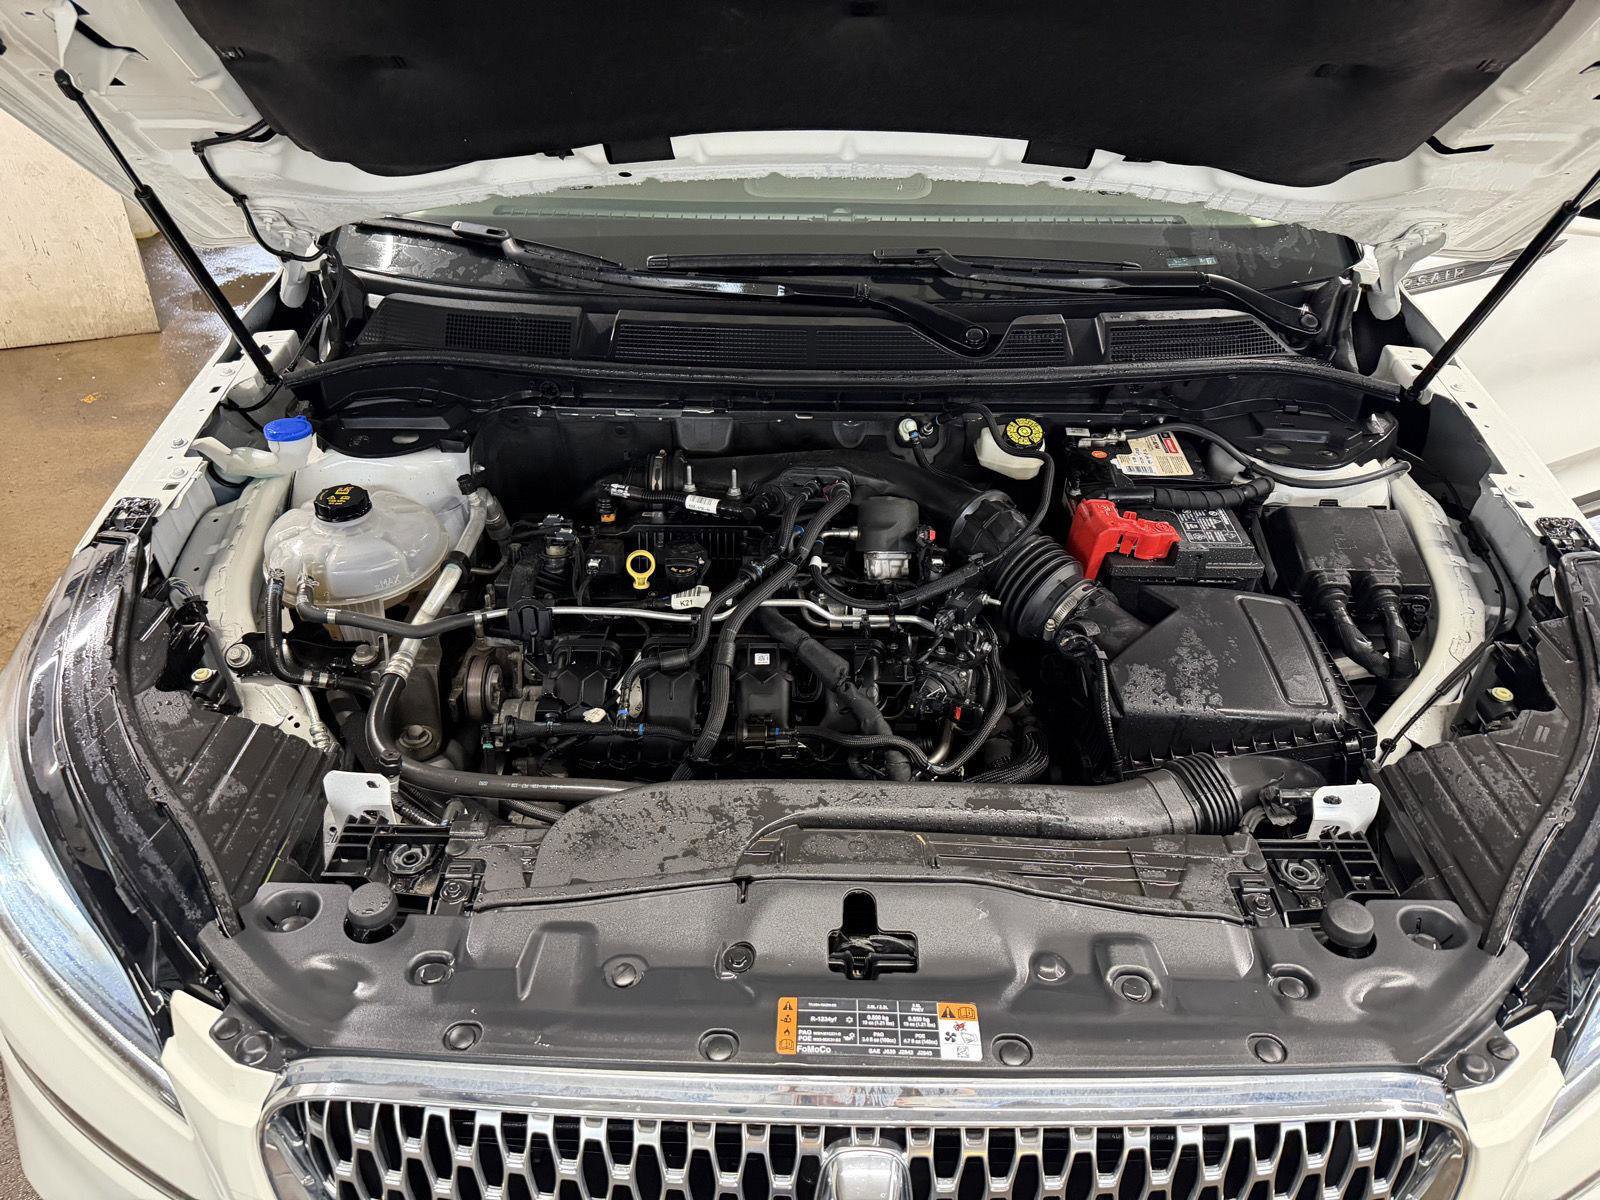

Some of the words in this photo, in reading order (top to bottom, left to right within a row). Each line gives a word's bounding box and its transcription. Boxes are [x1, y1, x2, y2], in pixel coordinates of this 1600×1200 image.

[680, 599, 693, 607] K21
[810, 1015, 838, 1024] R-1234yf
[797, 1045, 831, 1054] FoMoCo
